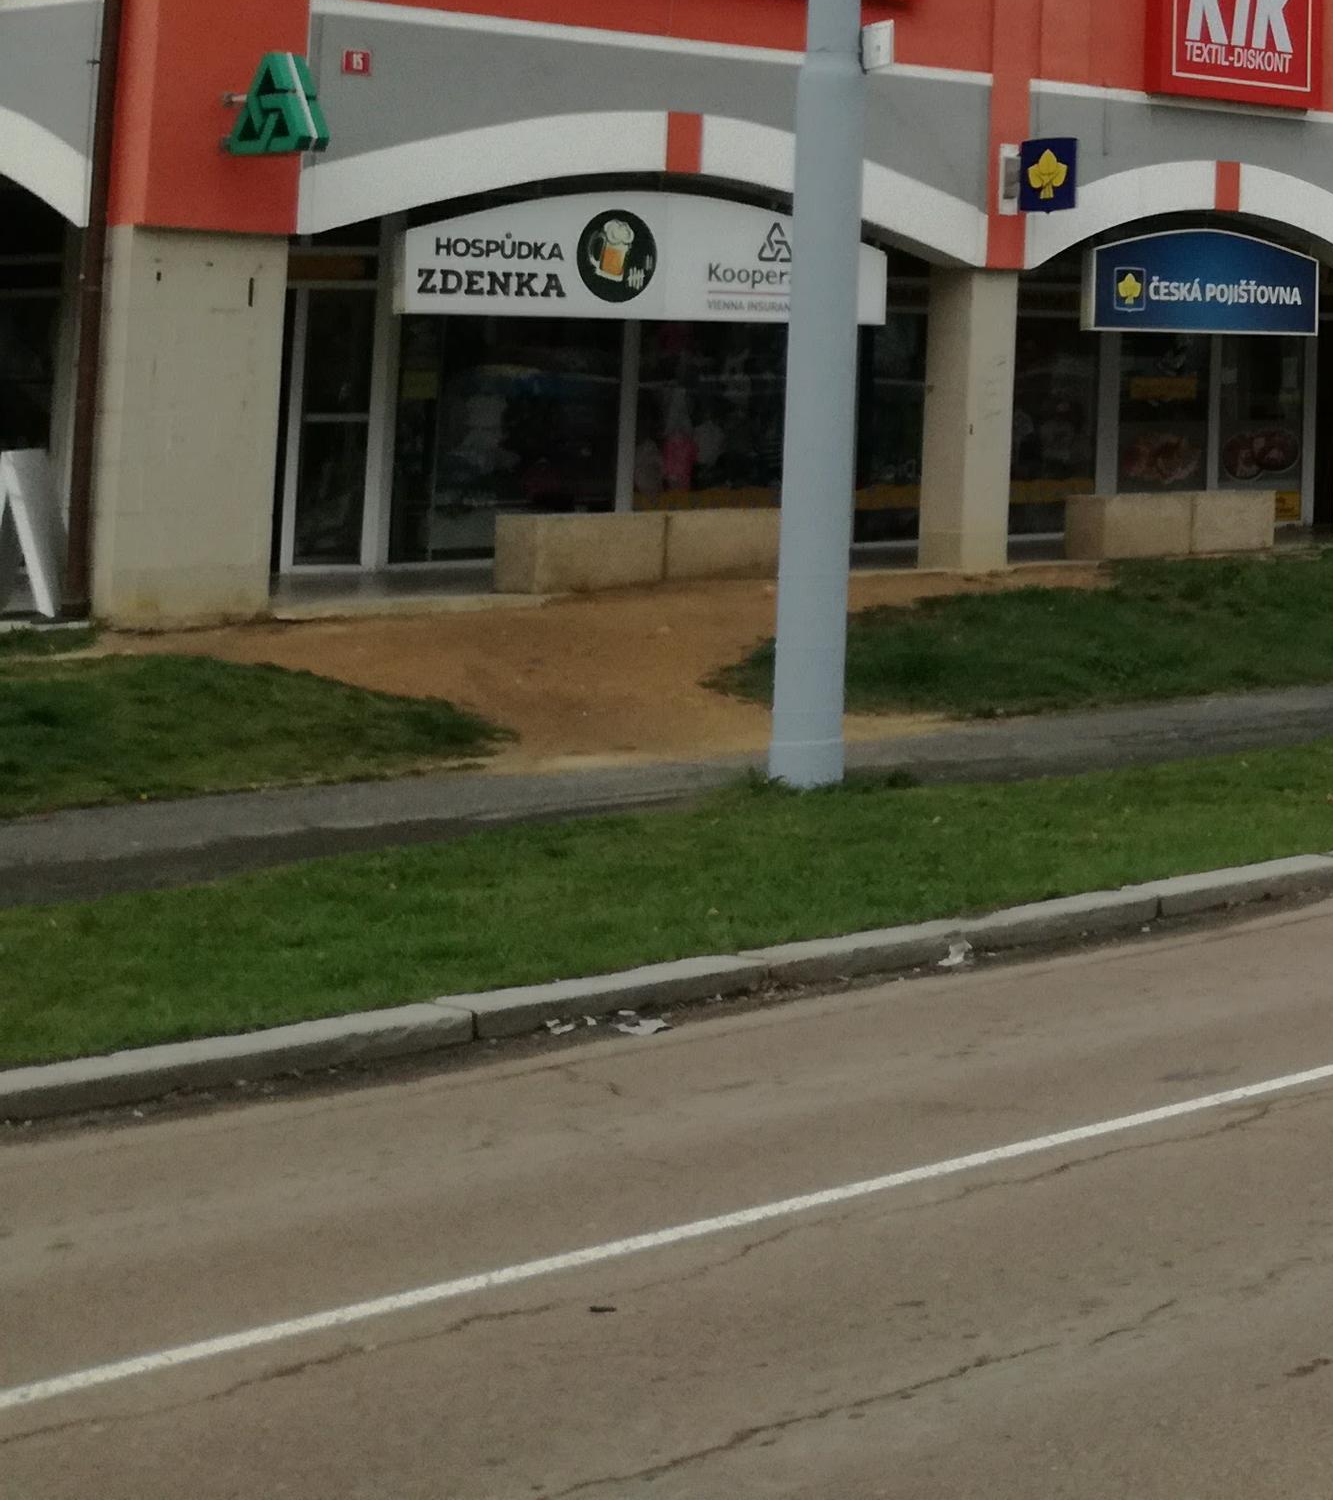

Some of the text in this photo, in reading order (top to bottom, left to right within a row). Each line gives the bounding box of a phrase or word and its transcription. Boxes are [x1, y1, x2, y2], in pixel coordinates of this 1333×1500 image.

[1184, 41, 1293, 74] TEXTIL-DISKONT
[434, 232, 565, 262] HOSPŮDKA
[417, 267, 566, 298] ZDENKA
[708, 262, 791, 290] Kooper
[1149, 275, 1302, 306] ČESKÁ POJIŠŤOVNA
[707, 299, 791, 314] VIENNA INSURAN
